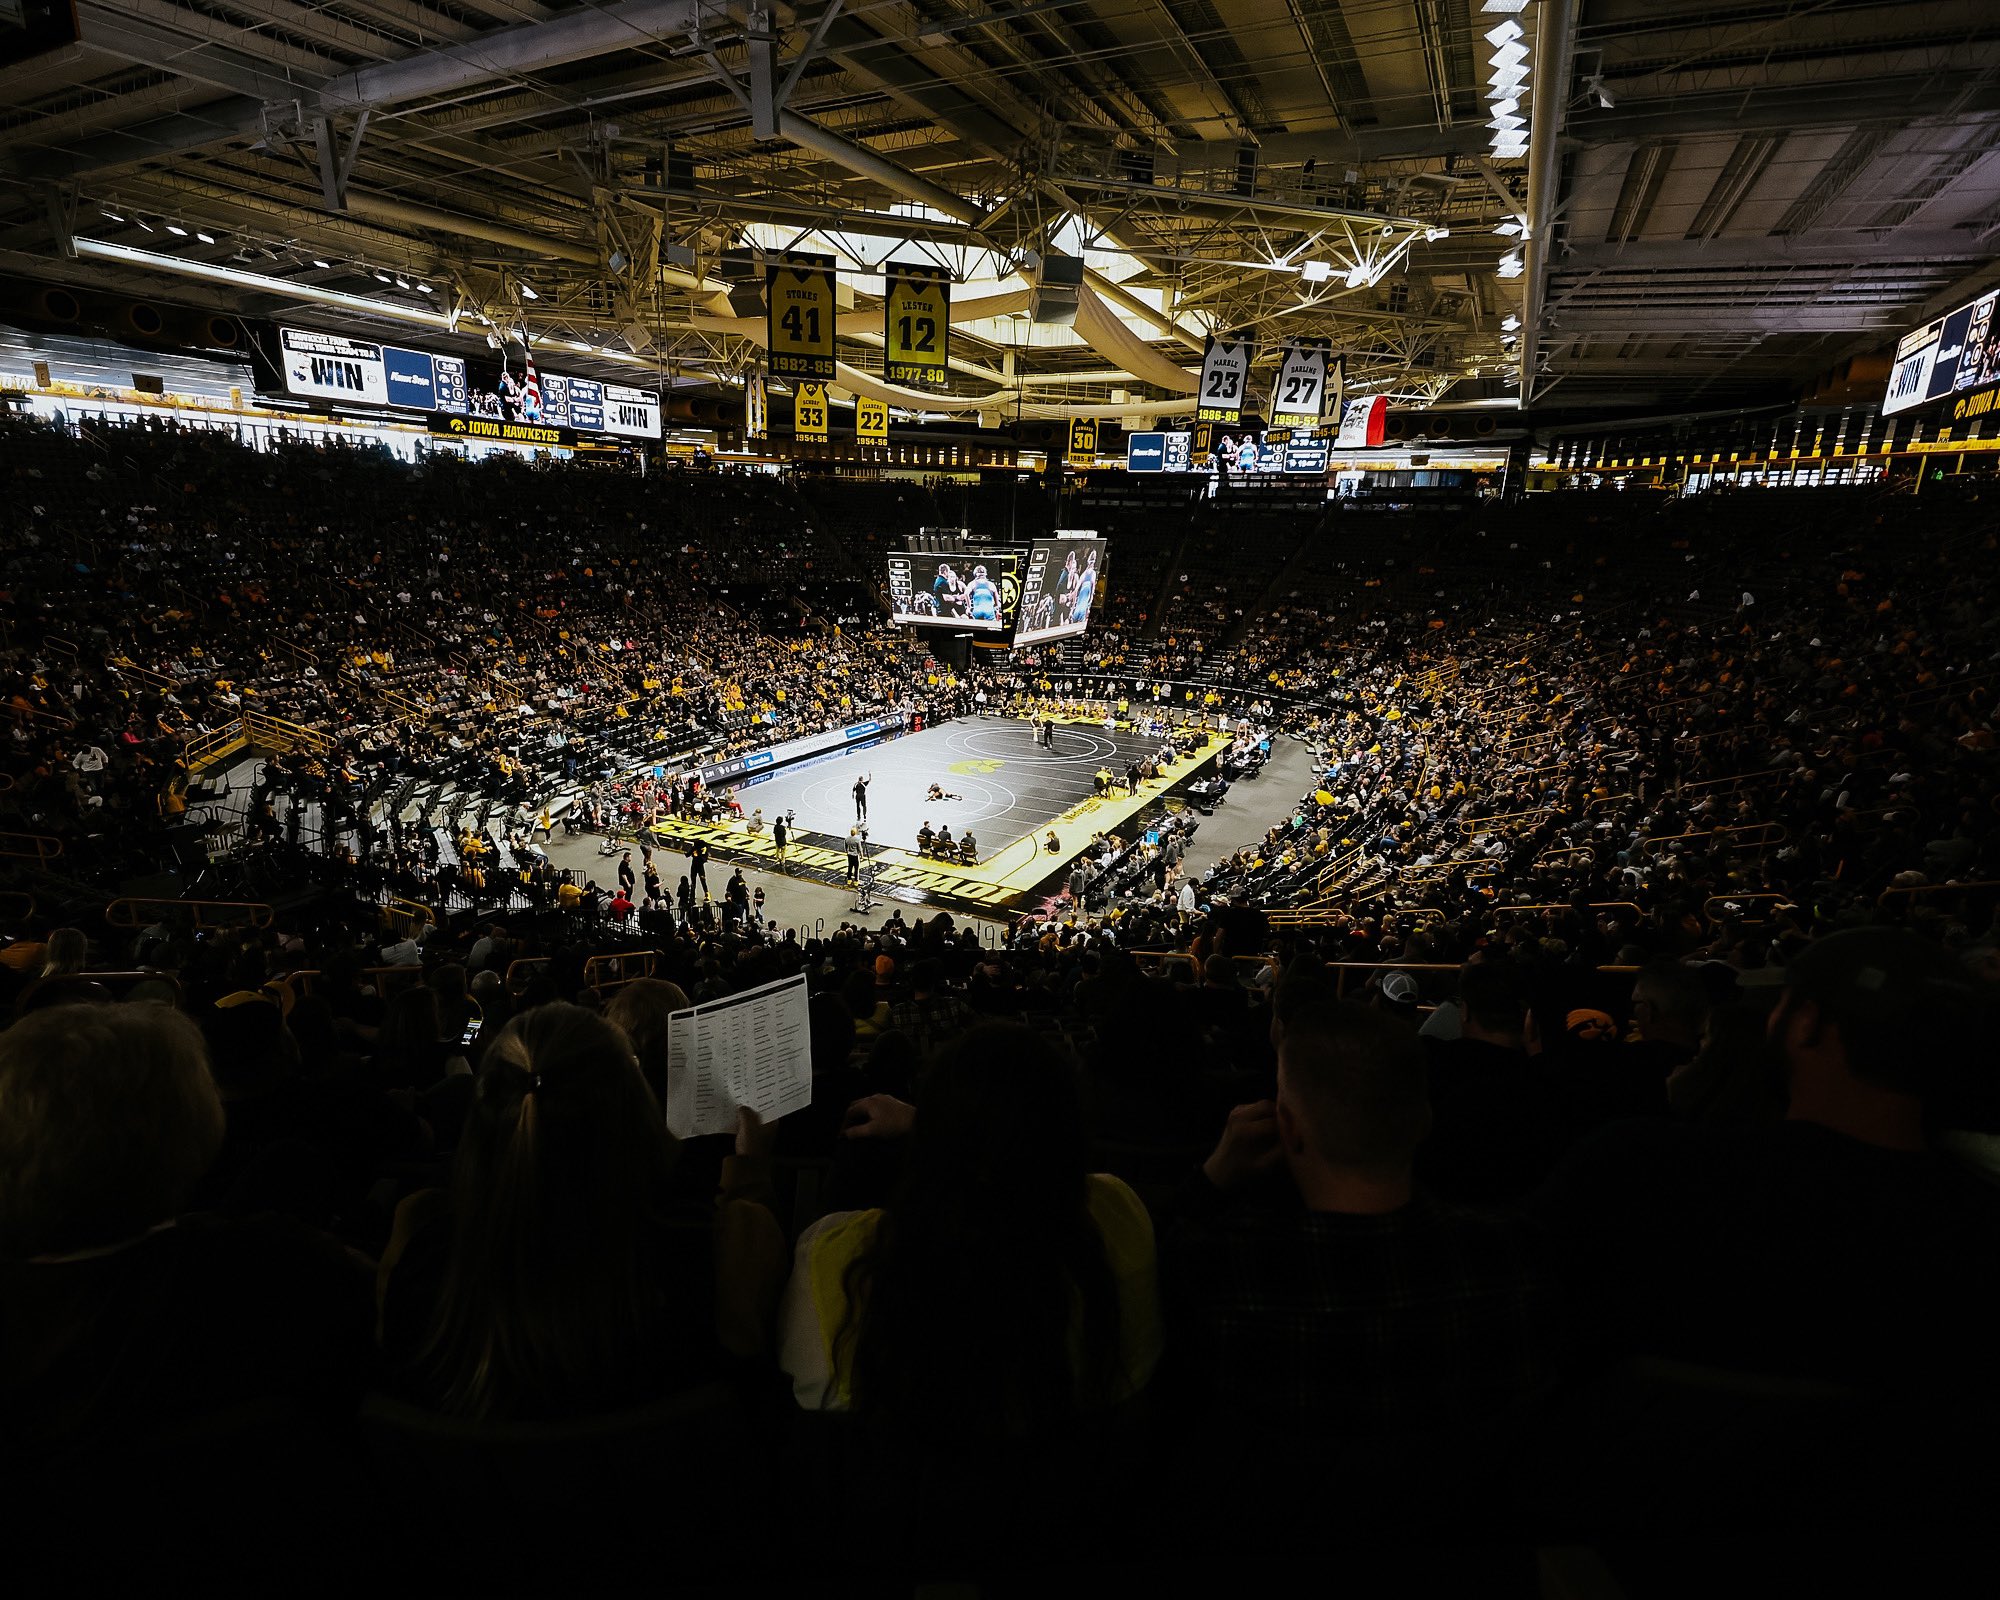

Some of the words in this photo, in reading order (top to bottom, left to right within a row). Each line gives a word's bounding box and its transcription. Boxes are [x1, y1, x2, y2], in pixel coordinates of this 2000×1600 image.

[786, 290, 818, 301] STOKES
[902, 301, 933, 313] LESTER
[781, 305, 821, 343] 41
[898, 316, 935, 352] 12
[772, 357, 833, 374] 1982-85
[1213, 359, 1239, 369] MARBLE
[1291, 366, 1317, 375] DARLING
[311, 357, 364, 391] WIN
[890, 366, 944, 382] 1977-80
[1206, 371, 1240, 399] 23
[1283, 377, 1317, 404] 27
[1965, 390, 1995, 417] IOWA
[619, 405, 648, 429] WIN
[800, 408, 823, 427] 33
[860, 411, 884, 430] 22
[1199, 409, 1239, 422] 1986-89
[1274, 415, 1318, 427] 1950-52
[469, 421, 500, 436] IOWA
[503, 425, 560, 442] HAWKEYES
[796, 434, 828, 443] 1954-56
[1197, 430, 1208, 448] 10
[857, 438, 887, 446] 1954-56
[1074, 433, 1094, 450] 30
[874, 865, 1021, 904] IOWA
